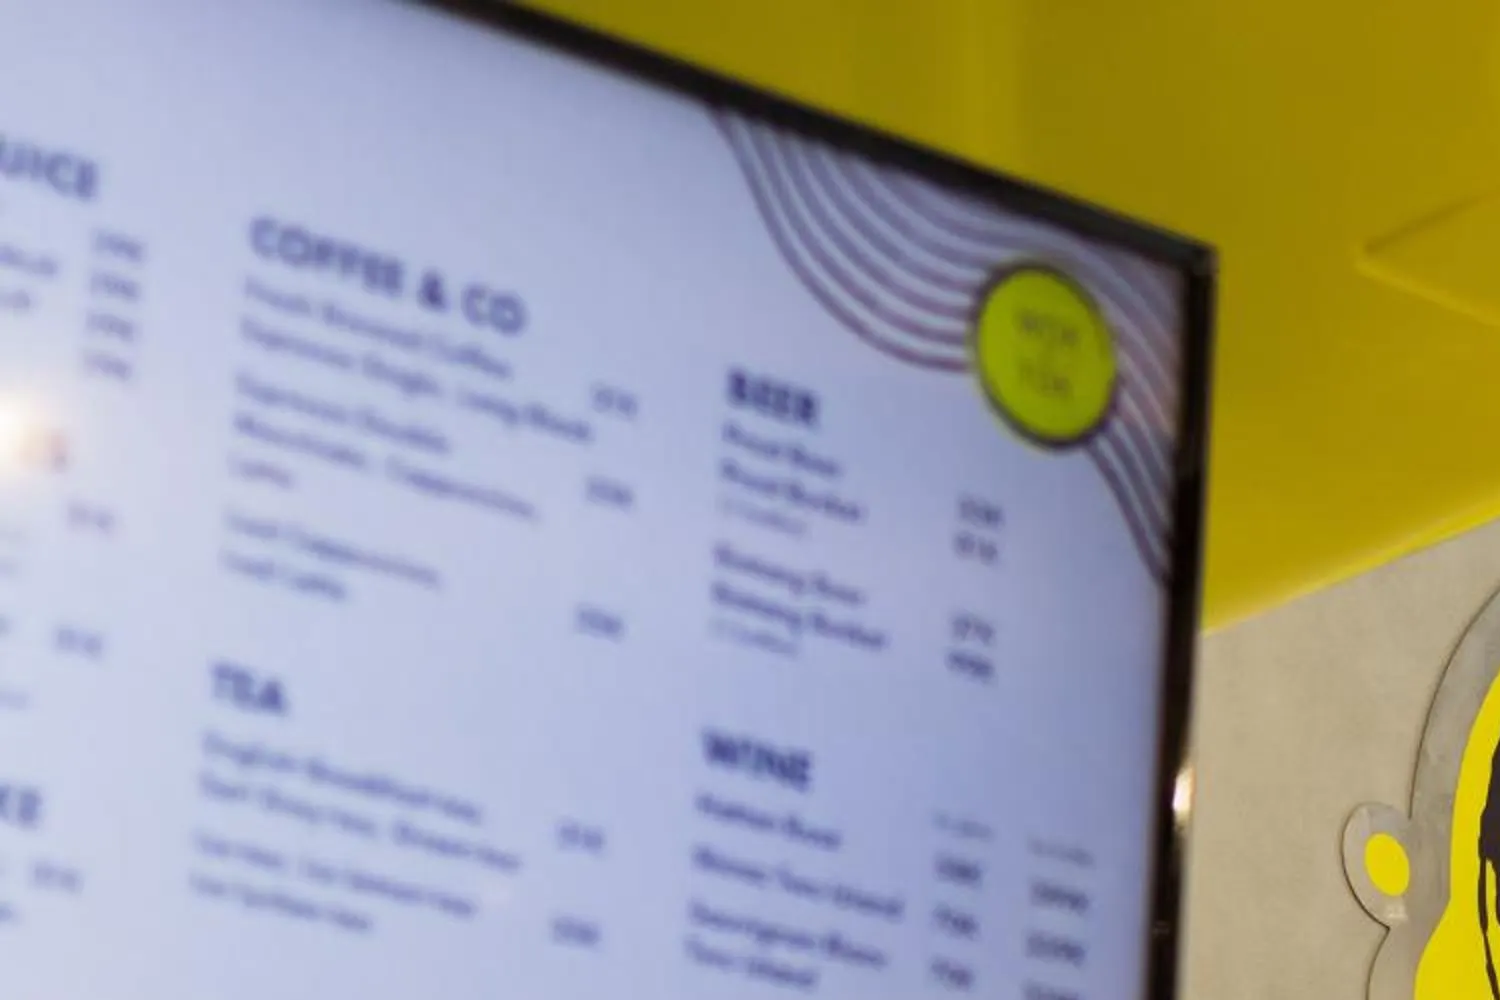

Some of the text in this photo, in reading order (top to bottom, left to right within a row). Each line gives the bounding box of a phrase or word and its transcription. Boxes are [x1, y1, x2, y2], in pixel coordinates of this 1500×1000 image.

[249, 215, 404, 297] COFFEE
[419, 270, 448, 313] &
[461, 283, 529, 336] CO
[726, 368, 819, 428] BEER
[211, 661, 289, 717] TEA
[703, 730, 812, 792] WINE
